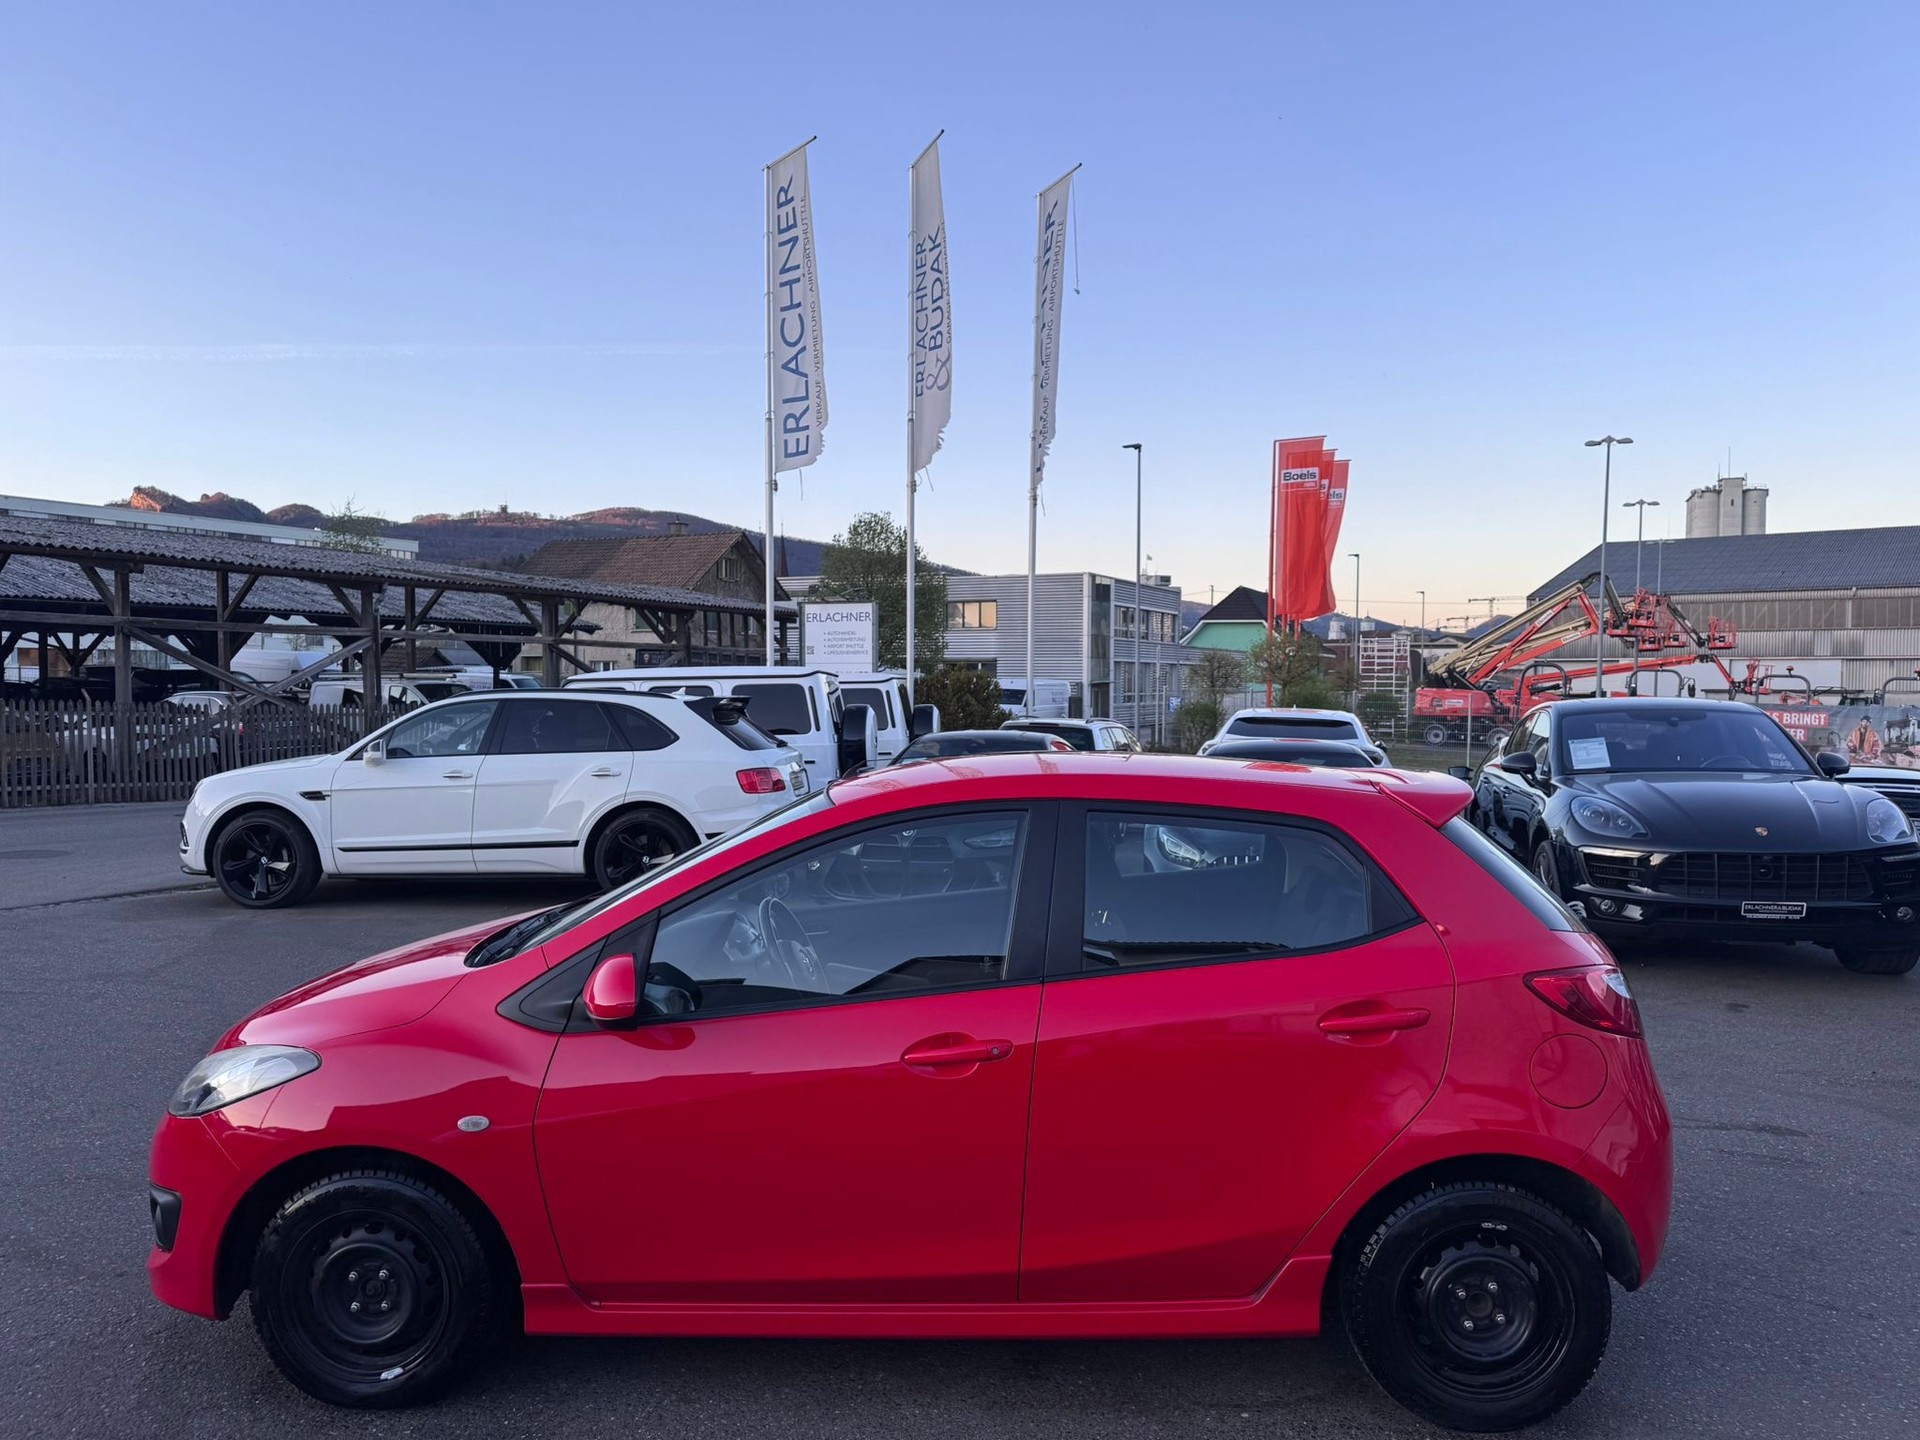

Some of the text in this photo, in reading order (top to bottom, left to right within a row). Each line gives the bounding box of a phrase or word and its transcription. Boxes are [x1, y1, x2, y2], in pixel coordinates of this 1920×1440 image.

[776, 174, 810, 459] ERLACHNER
[925, 225, 951, 392] & BUDAK
[1042, 320, 1053, 387] VERMIETUNG
[1049, 220, 1064, 312] AIRPORTSHUTTLE
[810, 300, 821, 373] VERMIETUNG
[815, 380, 824, 428] VERKAUF
[1283, 470, 1317, 481] Boels
[806, 611, 872, 623] ERLACHNER
[1783, 712, 1826, 726] BRINGT
